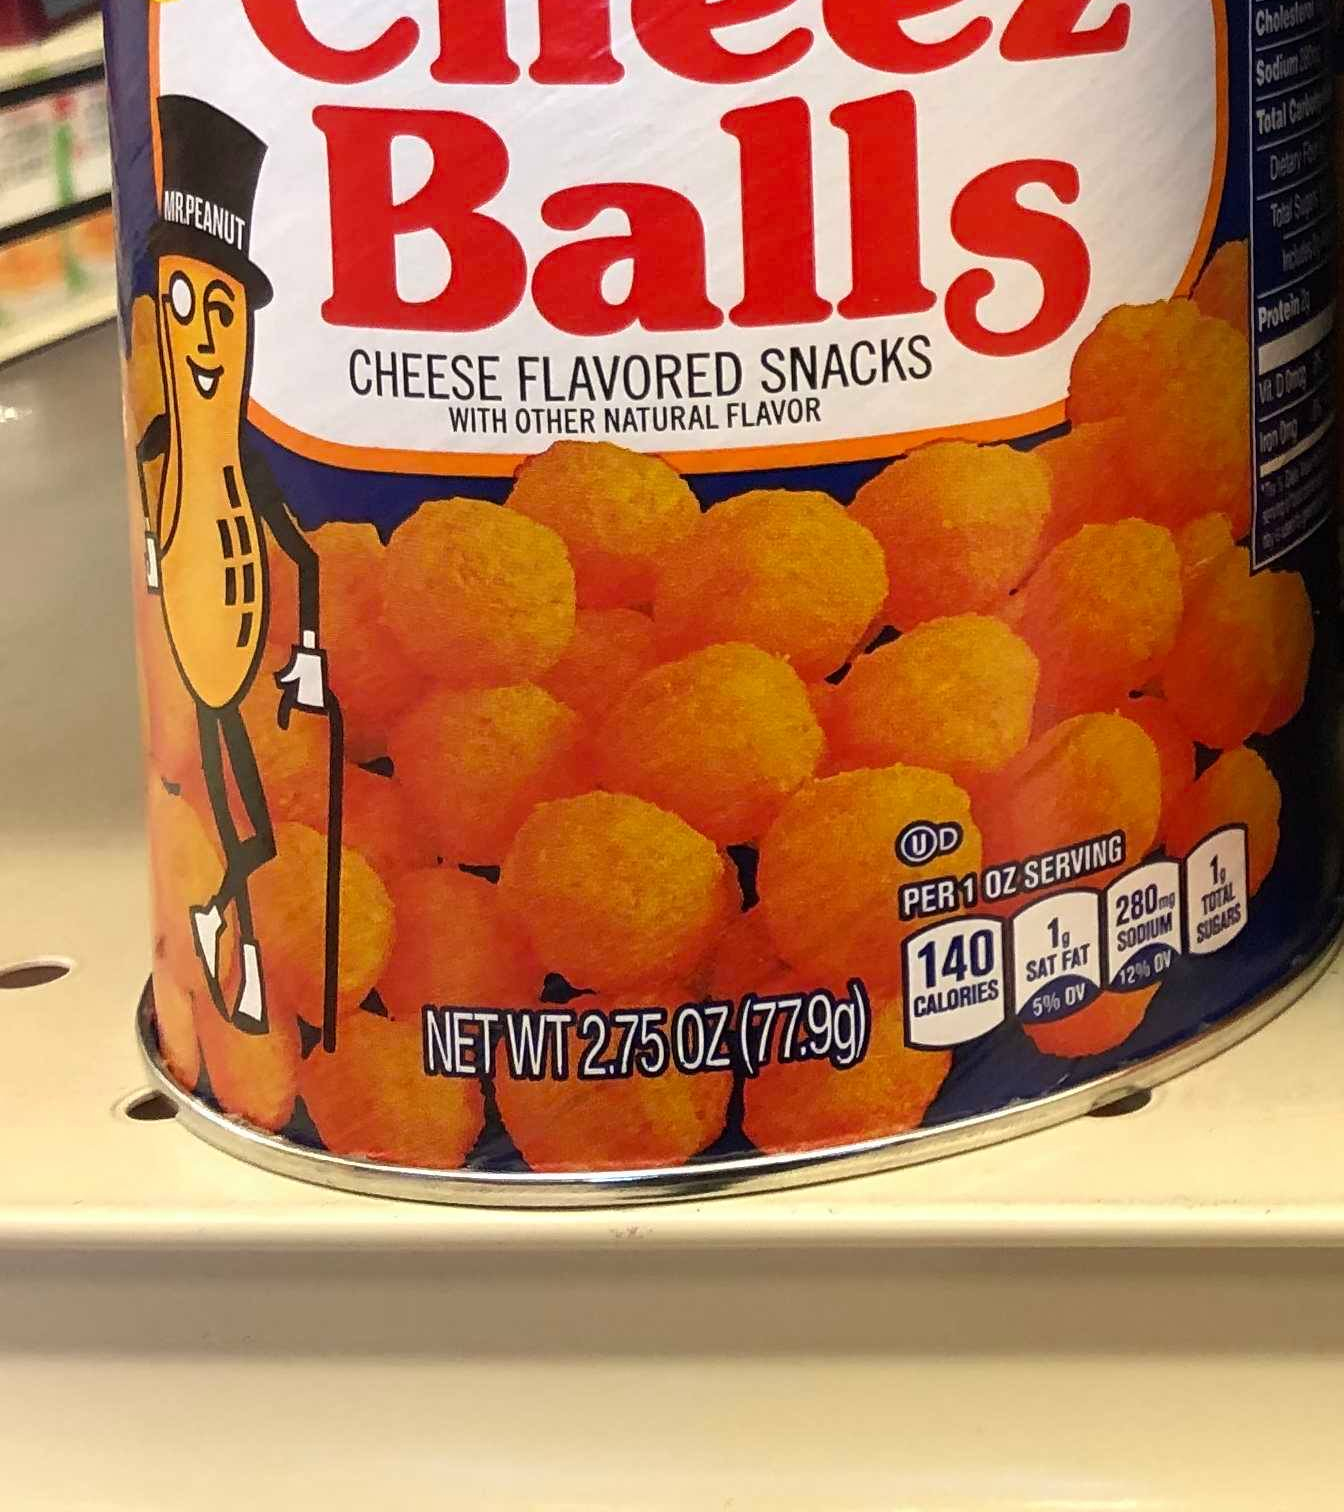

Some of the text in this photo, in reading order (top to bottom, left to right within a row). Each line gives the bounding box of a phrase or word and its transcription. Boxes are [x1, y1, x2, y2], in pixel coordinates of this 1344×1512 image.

[1256, 52, 1298, 86] Sodium
[1256, 101, 1286, 135] Total
[312, 90, 1091, 357] Balls
[1258, 292, 1300, 334] Protein
[349, 334, 932, 402] CHEESE FLAVORED SNACKS
[449, 398, 821, 434] WITH OTHER NATURAL FLAVOR
[904, 835, 1122, 914] PER 1 OZ SERVING
[1116, 884, 1175, 926] 280mg
[1202, 882, 1235, 912] TOTAL
[1117, 913, 1172, 952] SODIUM
[1197, 904, 1241, 943] SUGARS
[917, 930, 994, 988] 140
[1026, 944, 1089, 982] SAT FAT
[913, 979, 999, 1018] CALORIES
[1032, 995, 1061, 1017] 5%
[427, 984, 865, 1075] NET WT 2.75 OZ (77.9g)
